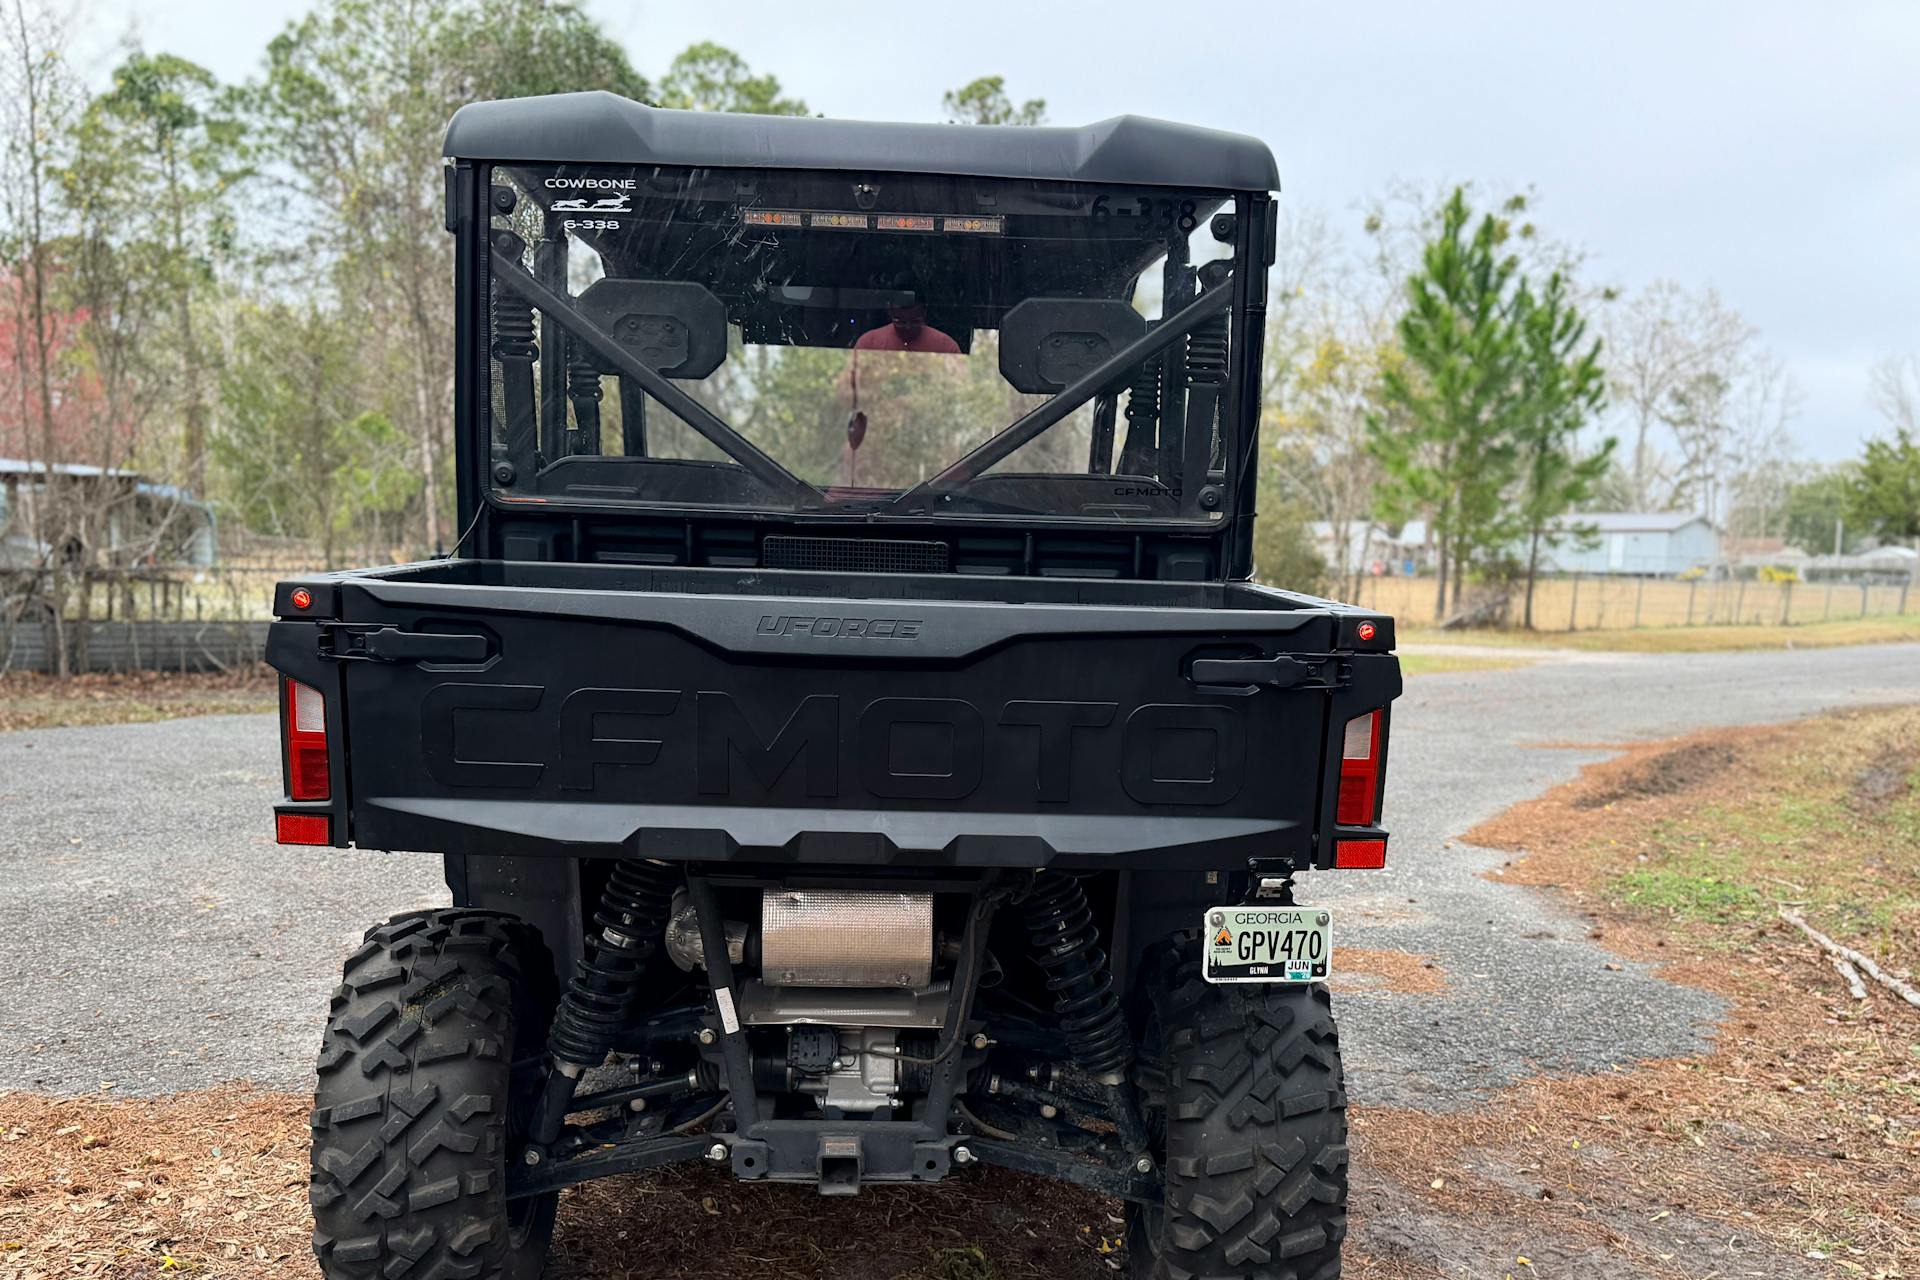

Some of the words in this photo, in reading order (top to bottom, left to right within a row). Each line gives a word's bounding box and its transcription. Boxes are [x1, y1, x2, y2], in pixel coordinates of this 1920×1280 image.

[544, 178, 637, 190] COWBONE
[563, 220, 620, 230] 6-338
[1114, 488, 1183, 497] CFMOTO
[756, 615, 924, 641] UFORCE
[420, 682, 1246, 805] CFMOTO
[1234, 912, 1303, 925] GEORGIA
[1238, 930, 1322, 960] GPV470
[1249, 966, 1269, 975] GLYNN
[1288, 961, 1309, 971] JUN
